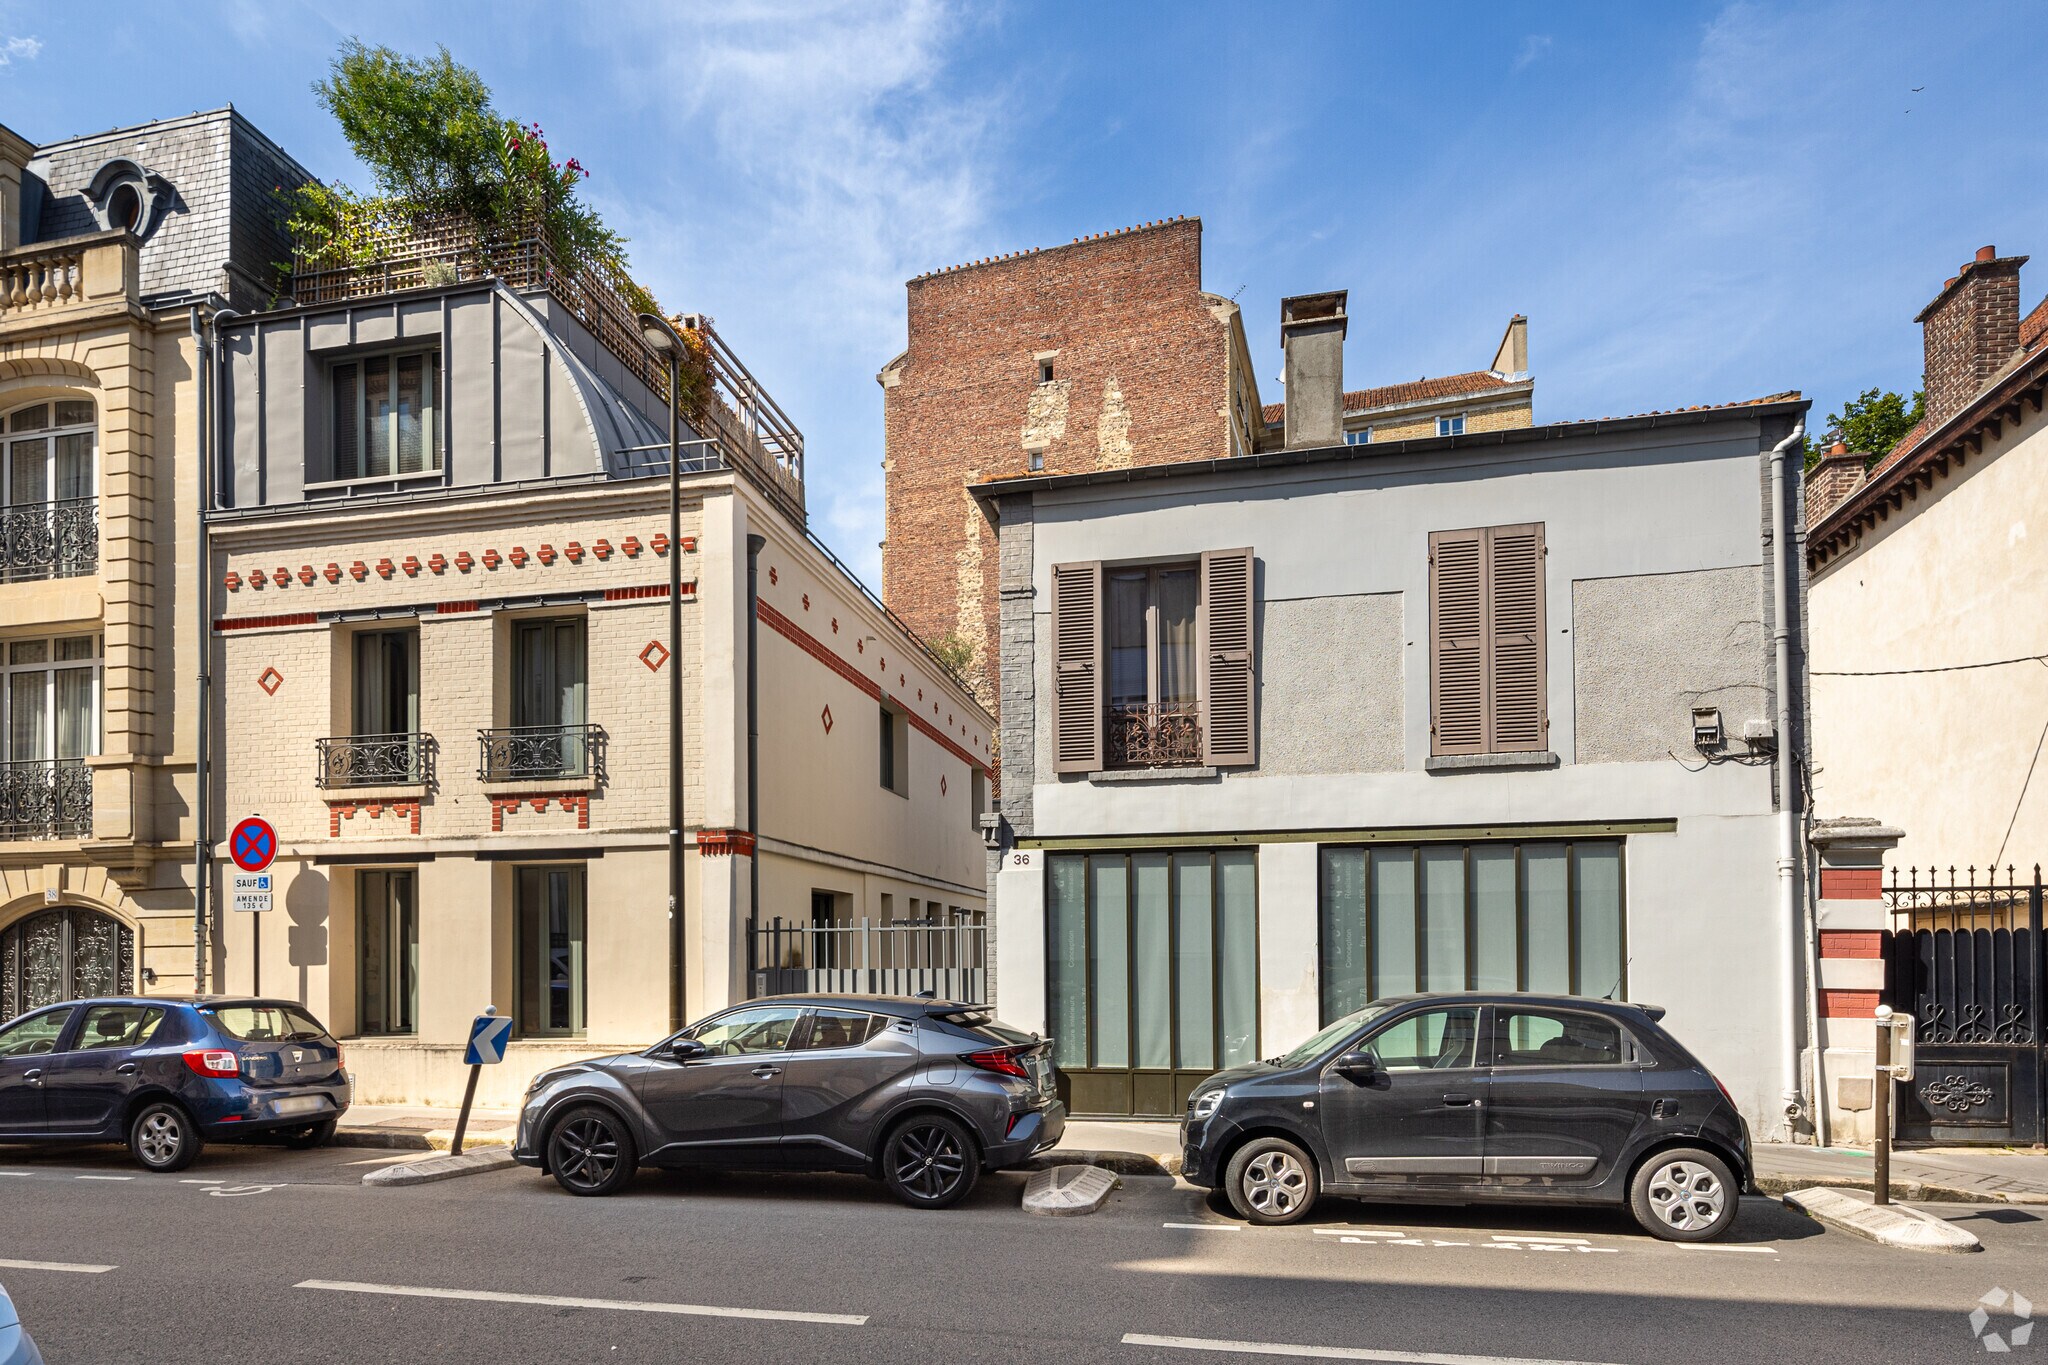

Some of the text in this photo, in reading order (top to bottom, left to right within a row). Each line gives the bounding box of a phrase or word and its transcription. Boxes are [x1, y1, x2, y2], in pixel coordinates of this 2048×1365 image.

[1013, 854, 1030, 866] 36
[236, 879, 257, 888] SAUF
[1067, 930, 1075, 968] Conception
